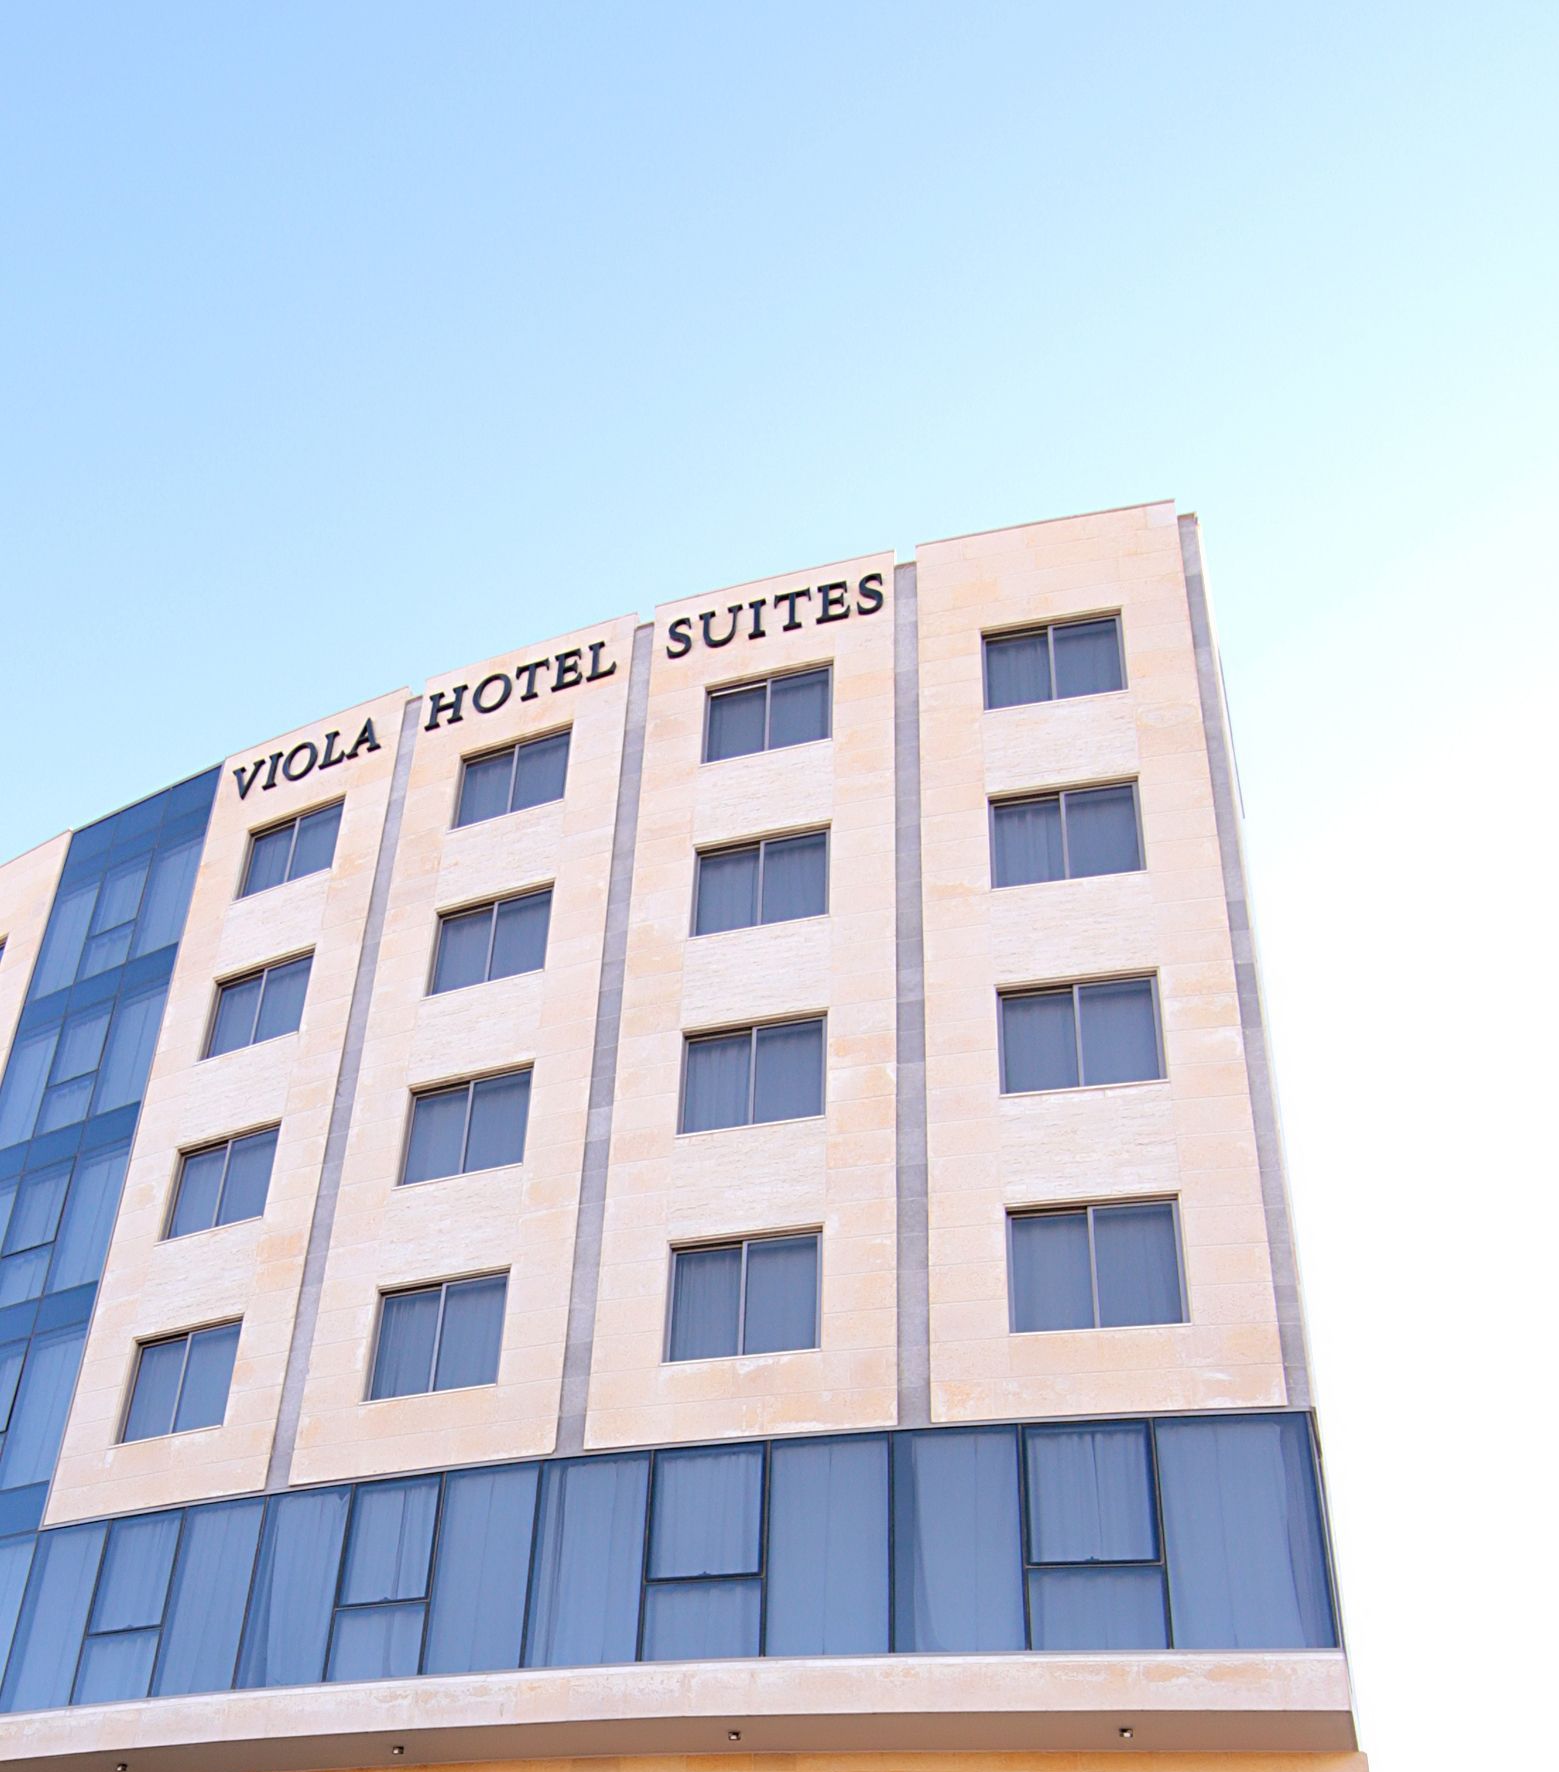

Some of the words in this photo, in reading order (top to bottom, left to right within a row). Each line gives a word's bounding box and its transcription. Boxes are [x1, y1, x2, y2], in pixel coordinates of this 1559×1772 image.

[231, 717, 381, 800] VIOLA
[424, 641, 618, 732] HOTEL
[665, 572, 885, 660] SUITES
